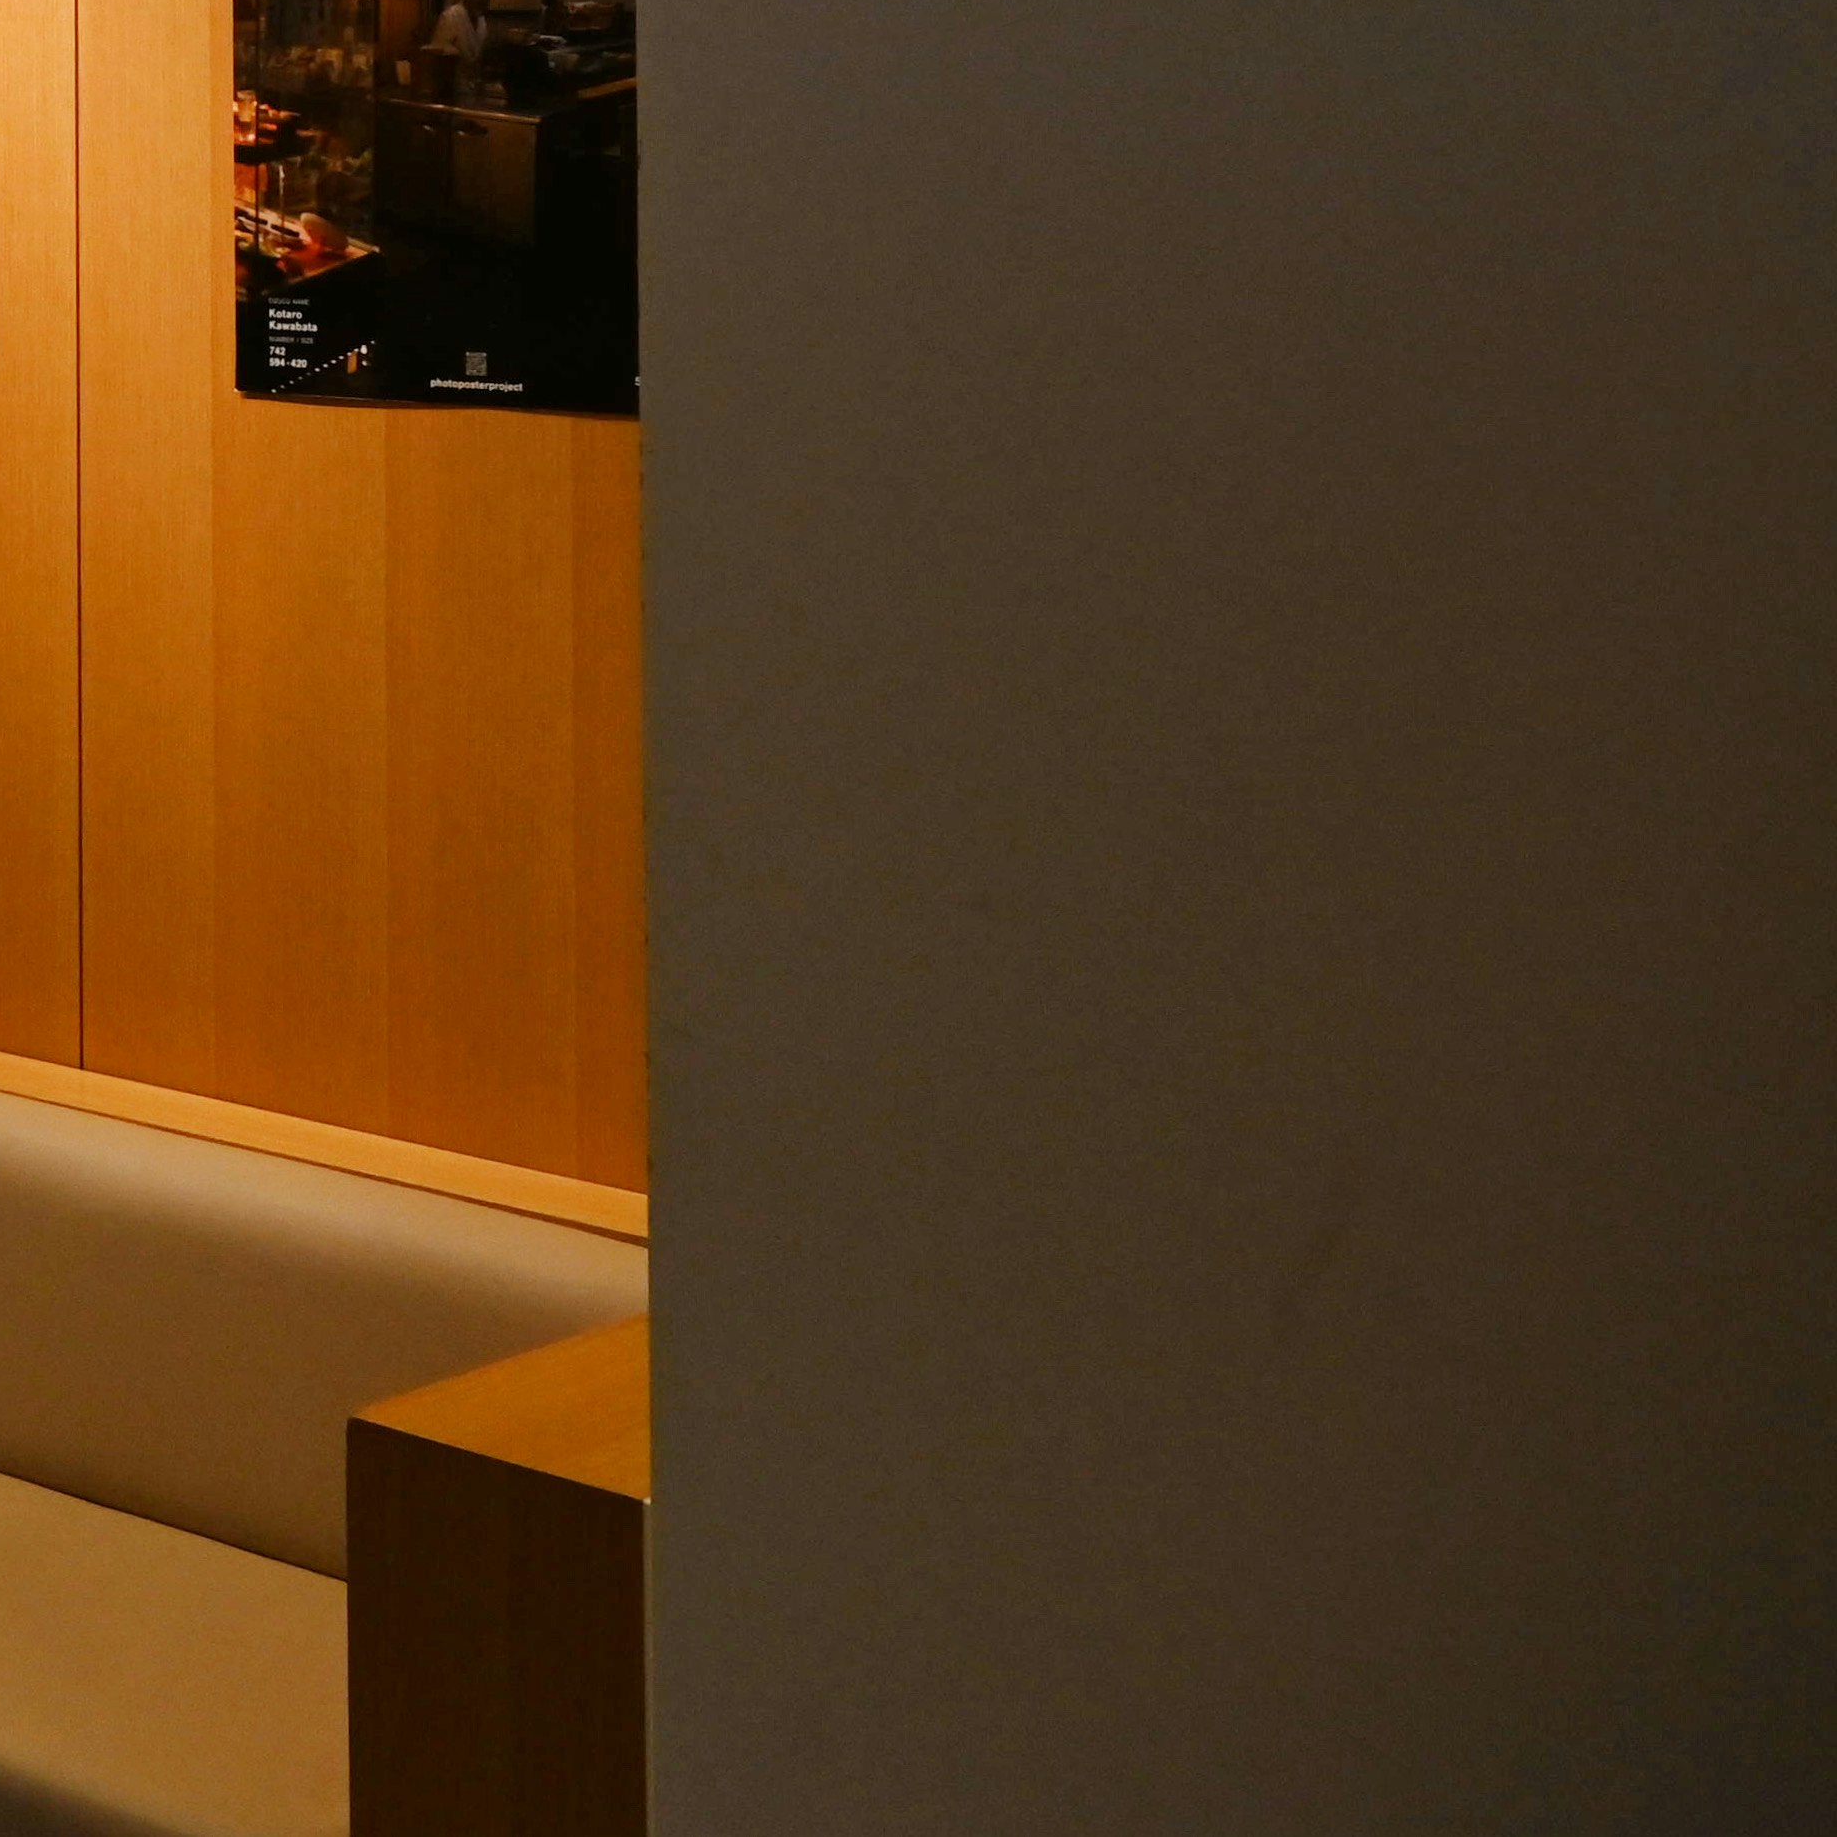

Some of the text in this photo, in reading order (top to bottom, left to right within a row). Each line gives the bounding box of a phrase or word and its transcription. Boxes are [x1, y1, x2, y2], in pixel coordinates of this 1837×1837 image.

[268, 308, 303, 320] Kotaro
[269, 320, 318, 332] Kawabata
[268, 346, 287, 357] 742
[430, 378, 523, 392] photoposterproject
